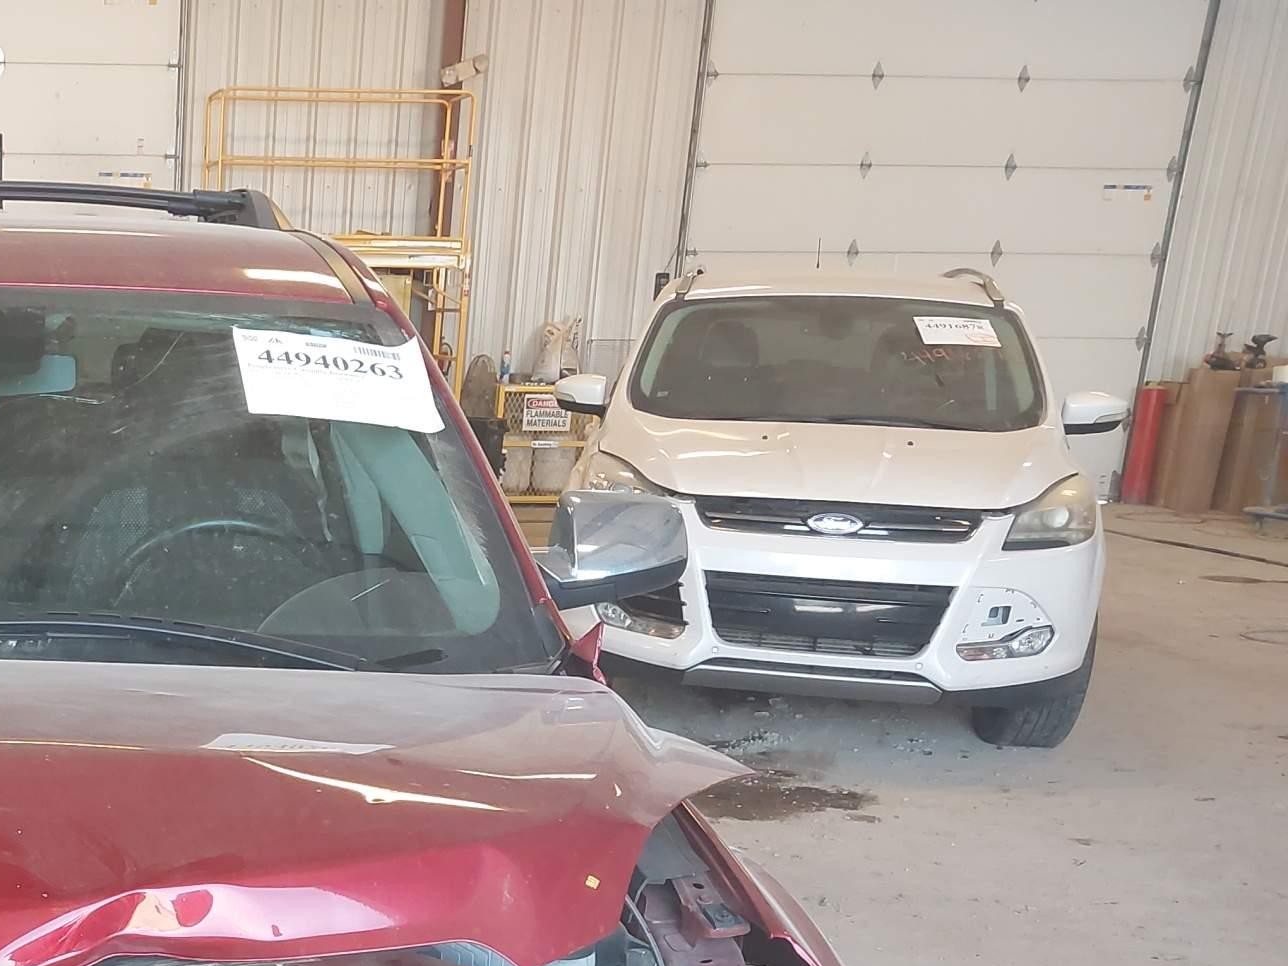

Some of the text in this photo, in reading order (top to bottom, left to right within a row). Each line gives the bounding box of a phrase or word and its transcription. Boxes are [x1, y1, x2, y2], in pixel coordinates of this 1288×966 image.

[258, 349, 404, 380] 44940263
[532, 400, 559, 408] DANG
[525, 410, 569, 419] FLAMMABLE
[526, 419, 567, 428] MATERIALS
